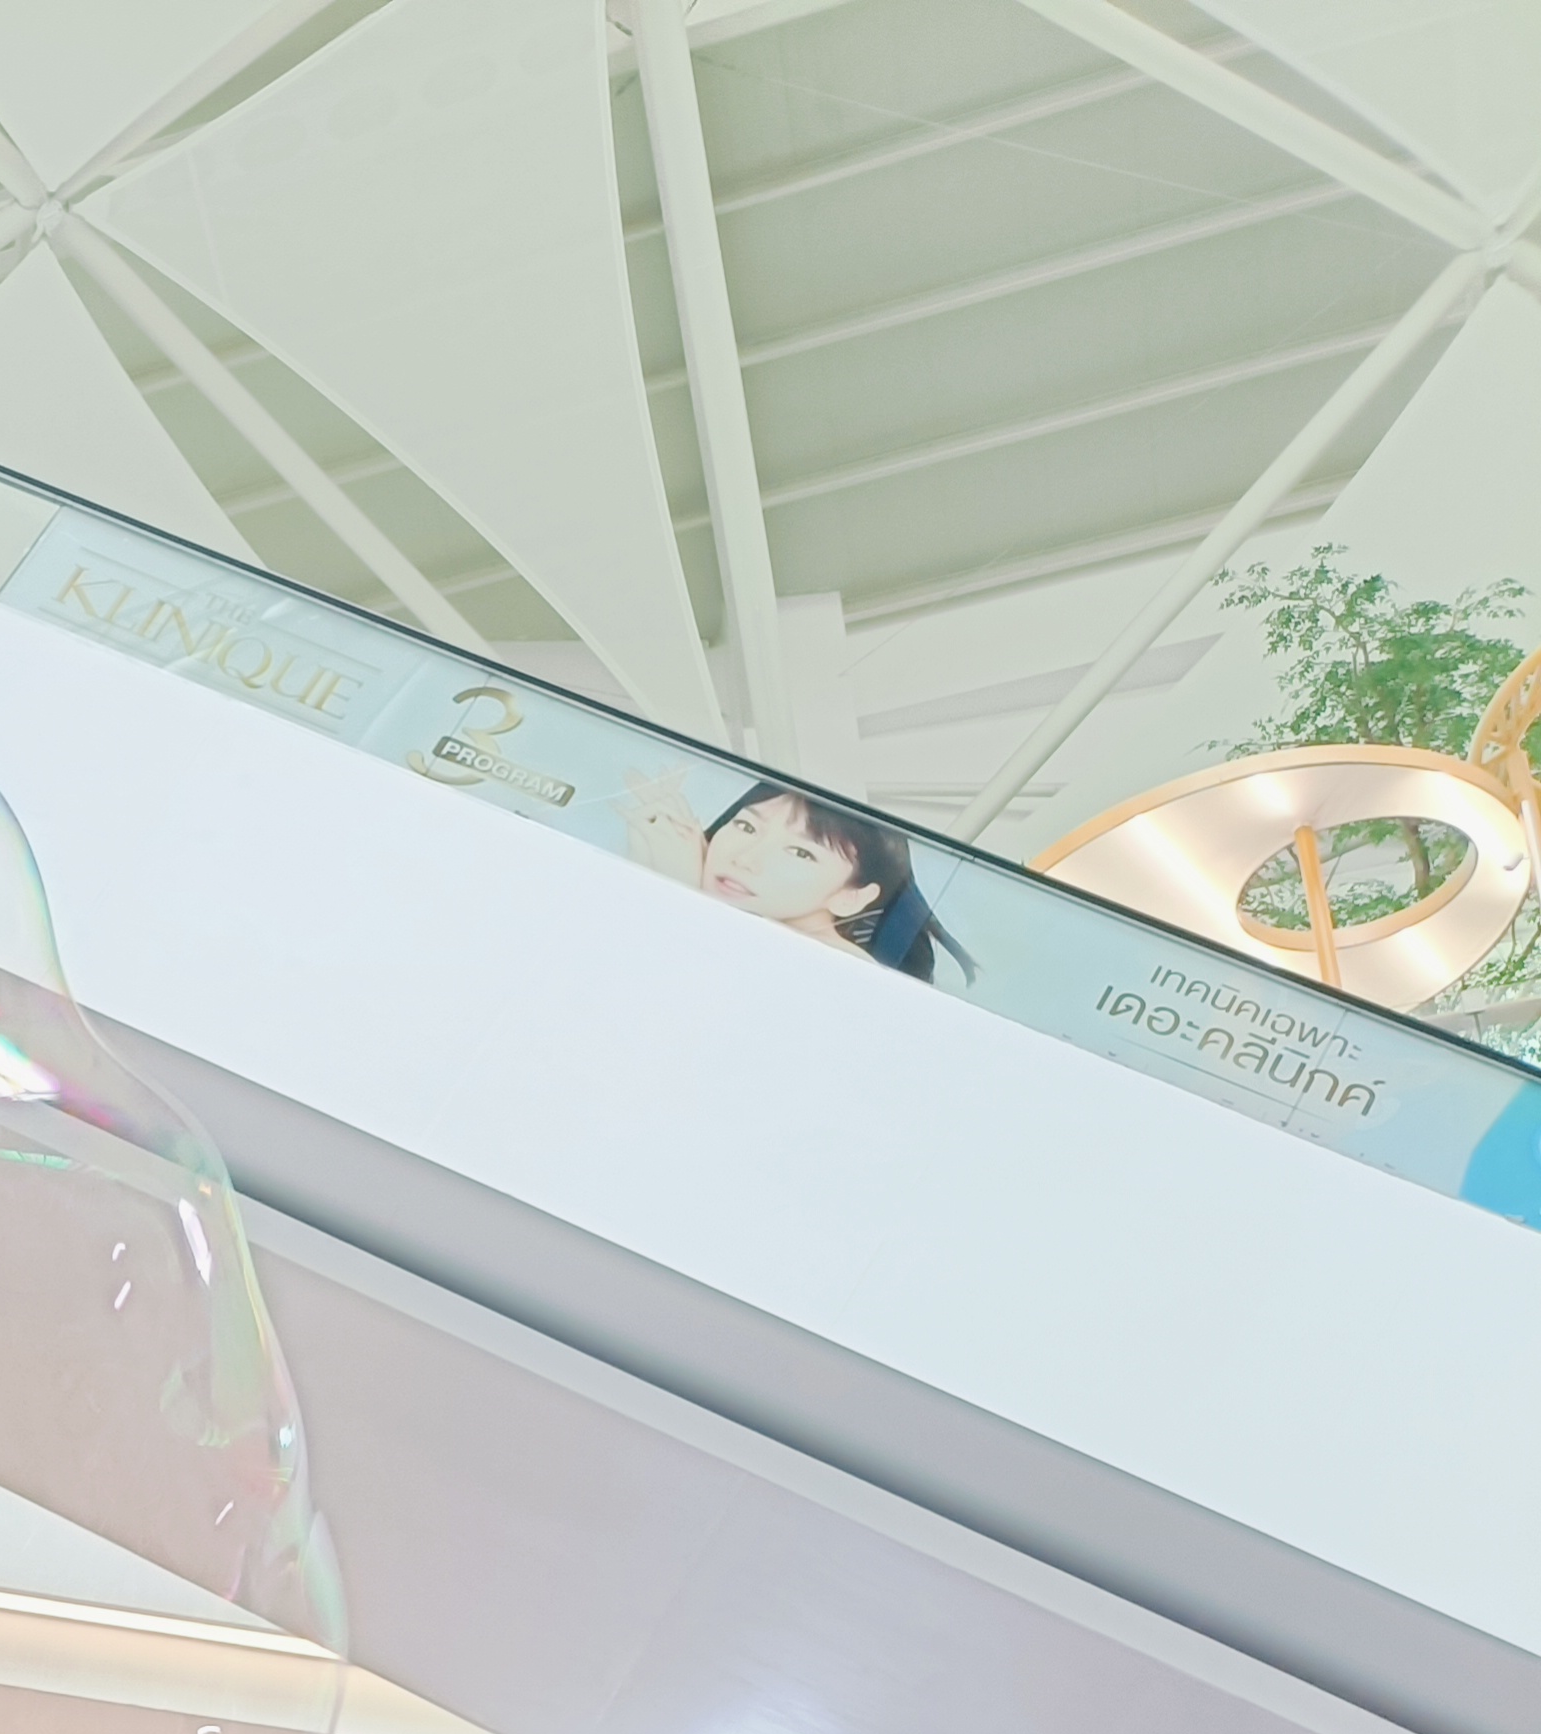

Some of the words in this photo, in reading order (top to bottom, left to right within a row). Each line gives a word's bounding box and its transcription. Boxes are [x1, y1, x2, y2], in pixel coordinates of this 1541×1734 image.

[51, 565, 366, 721] KLINIQUE
[406, 685, 524, 788] 3
[440, 740, 568, 806] PROGRAM
[1150, 962, 1364, 1062] เทคนิคเฉพาะ
